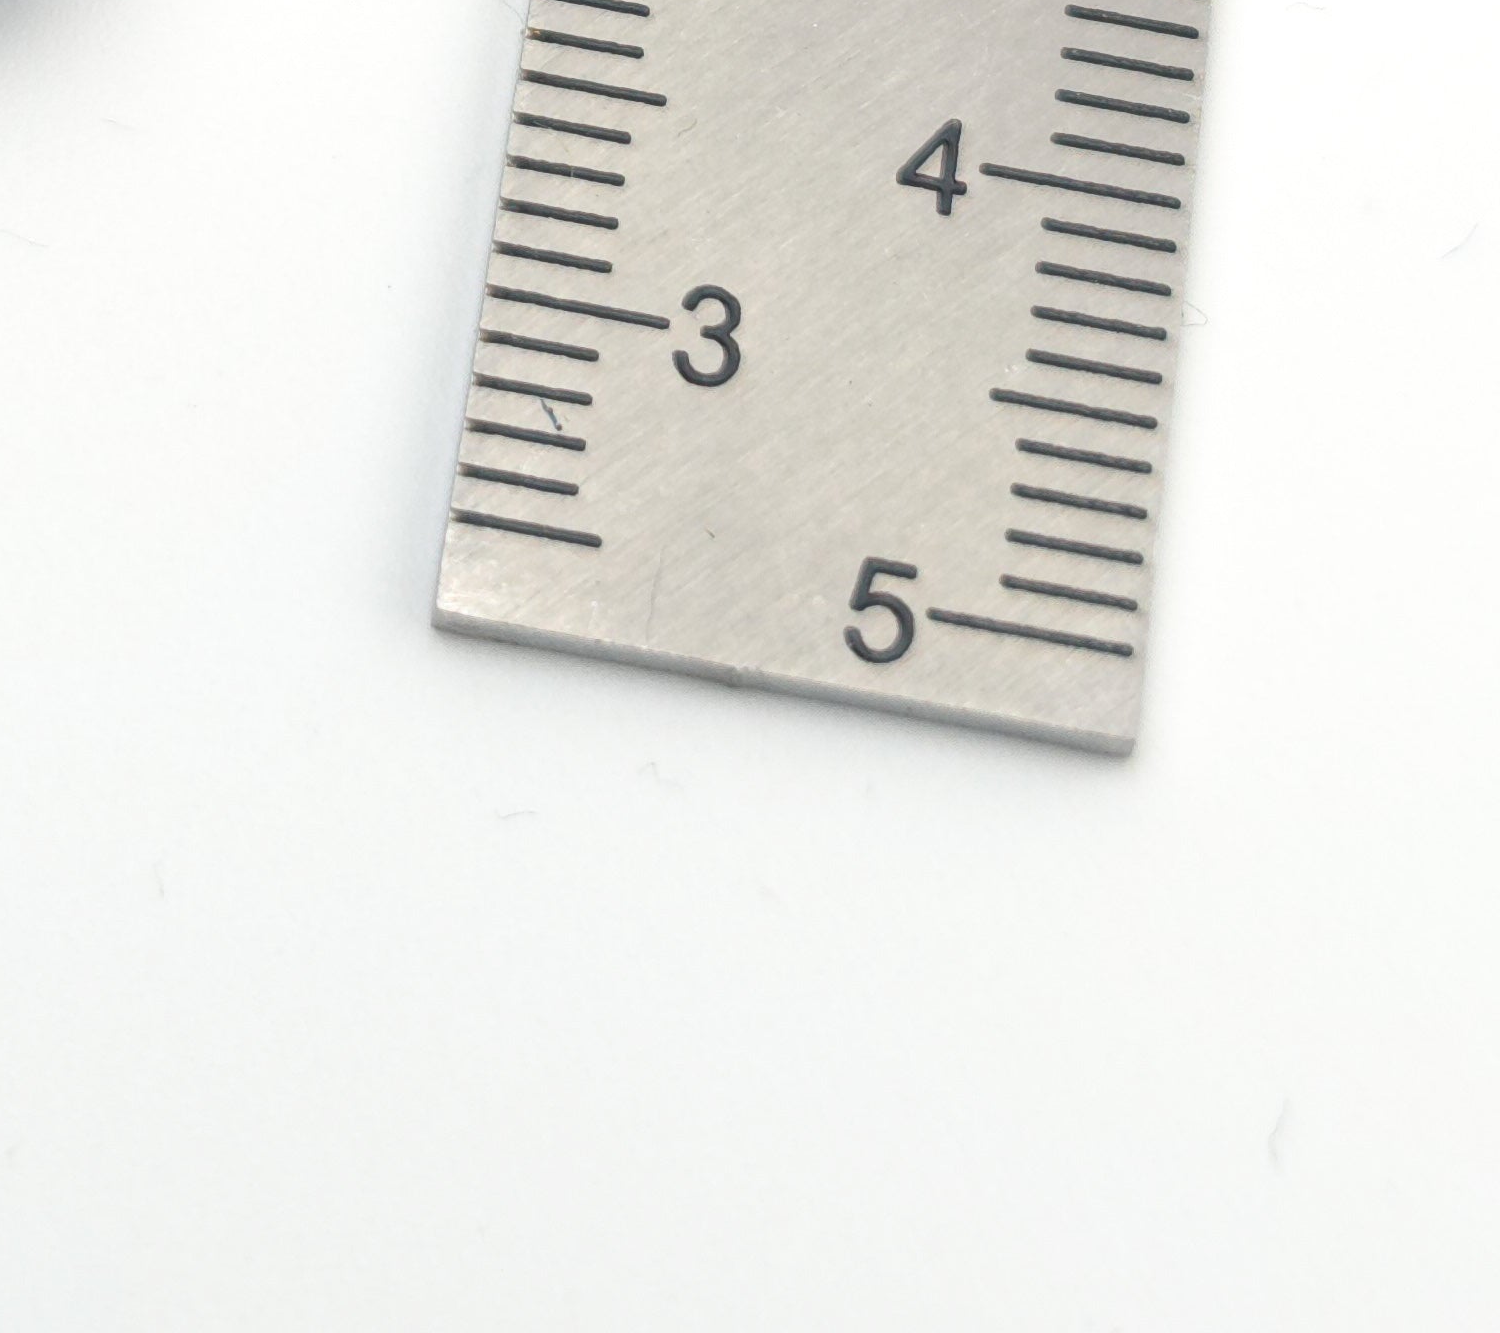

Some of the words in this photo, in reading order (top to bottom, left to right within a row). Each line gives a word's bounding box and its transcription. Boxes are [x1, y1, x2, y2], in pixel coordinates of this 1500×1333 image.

[896, 119, 967, 216] 4
[672, 285, 741, 387] 3
[845, 557, 917, 665] 5
